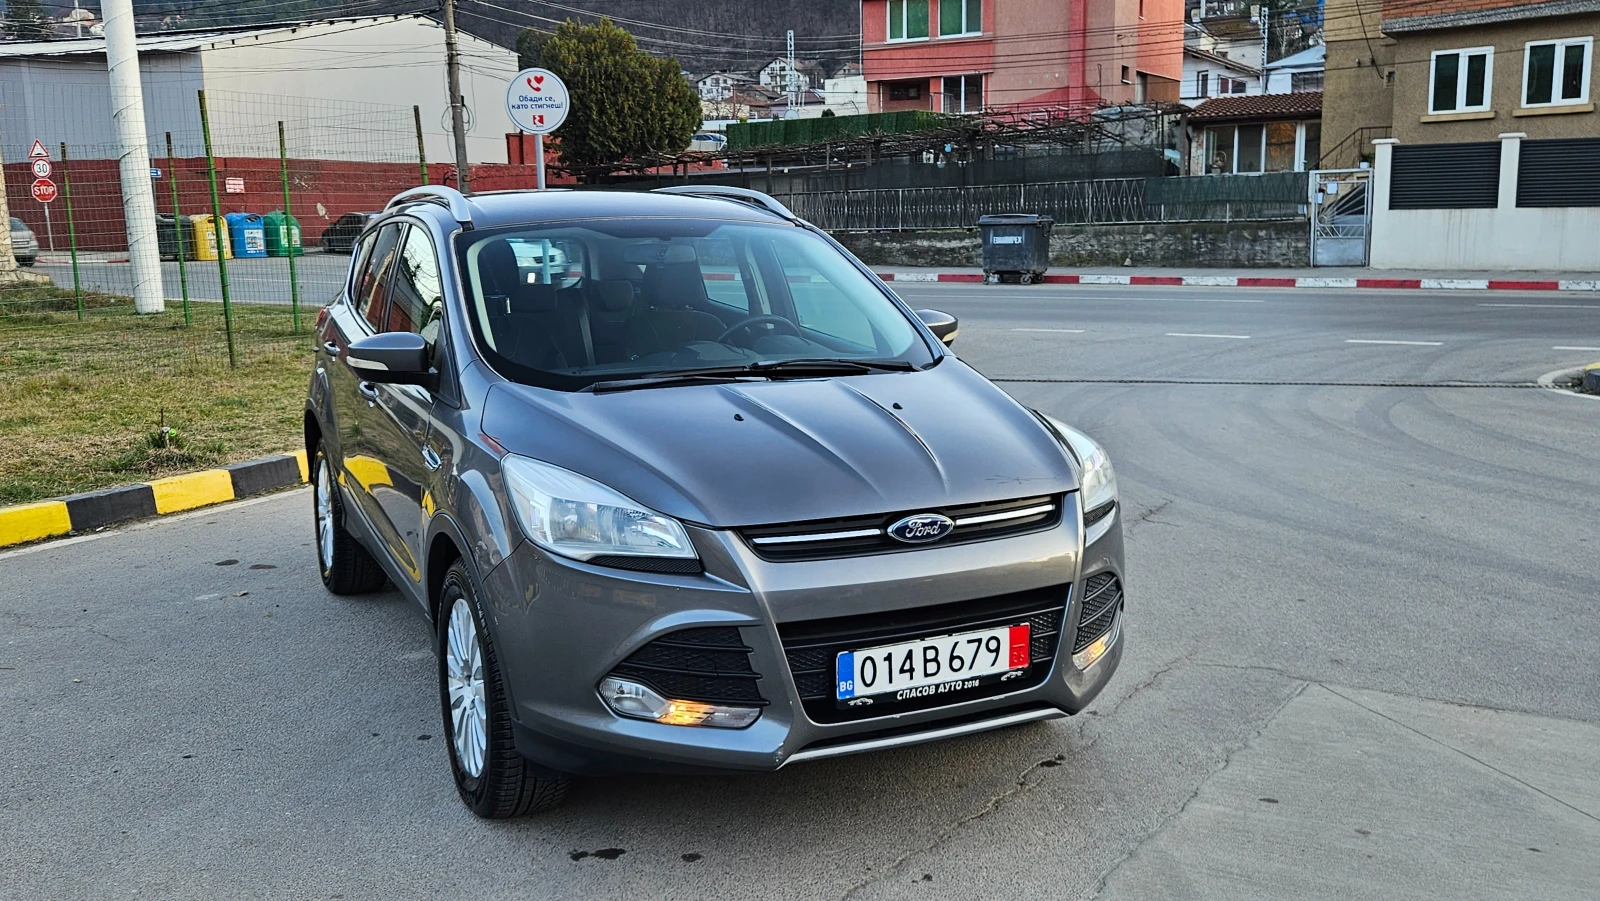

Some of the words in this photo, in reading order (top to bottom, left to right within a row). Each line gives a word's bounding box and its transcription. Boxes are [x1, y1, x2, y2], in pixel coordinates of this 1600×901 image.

[36, 163, 48, 174] 30
[33, 185, 55, 195] STOP
[905, 518, 941, 538] Ford
[839, 680, 854, 692] BG
[896, 684, 936, 701] СПАСОВ
[937, 680, 963, 694] АУТО
[963, 679, 980, 690] 2016
